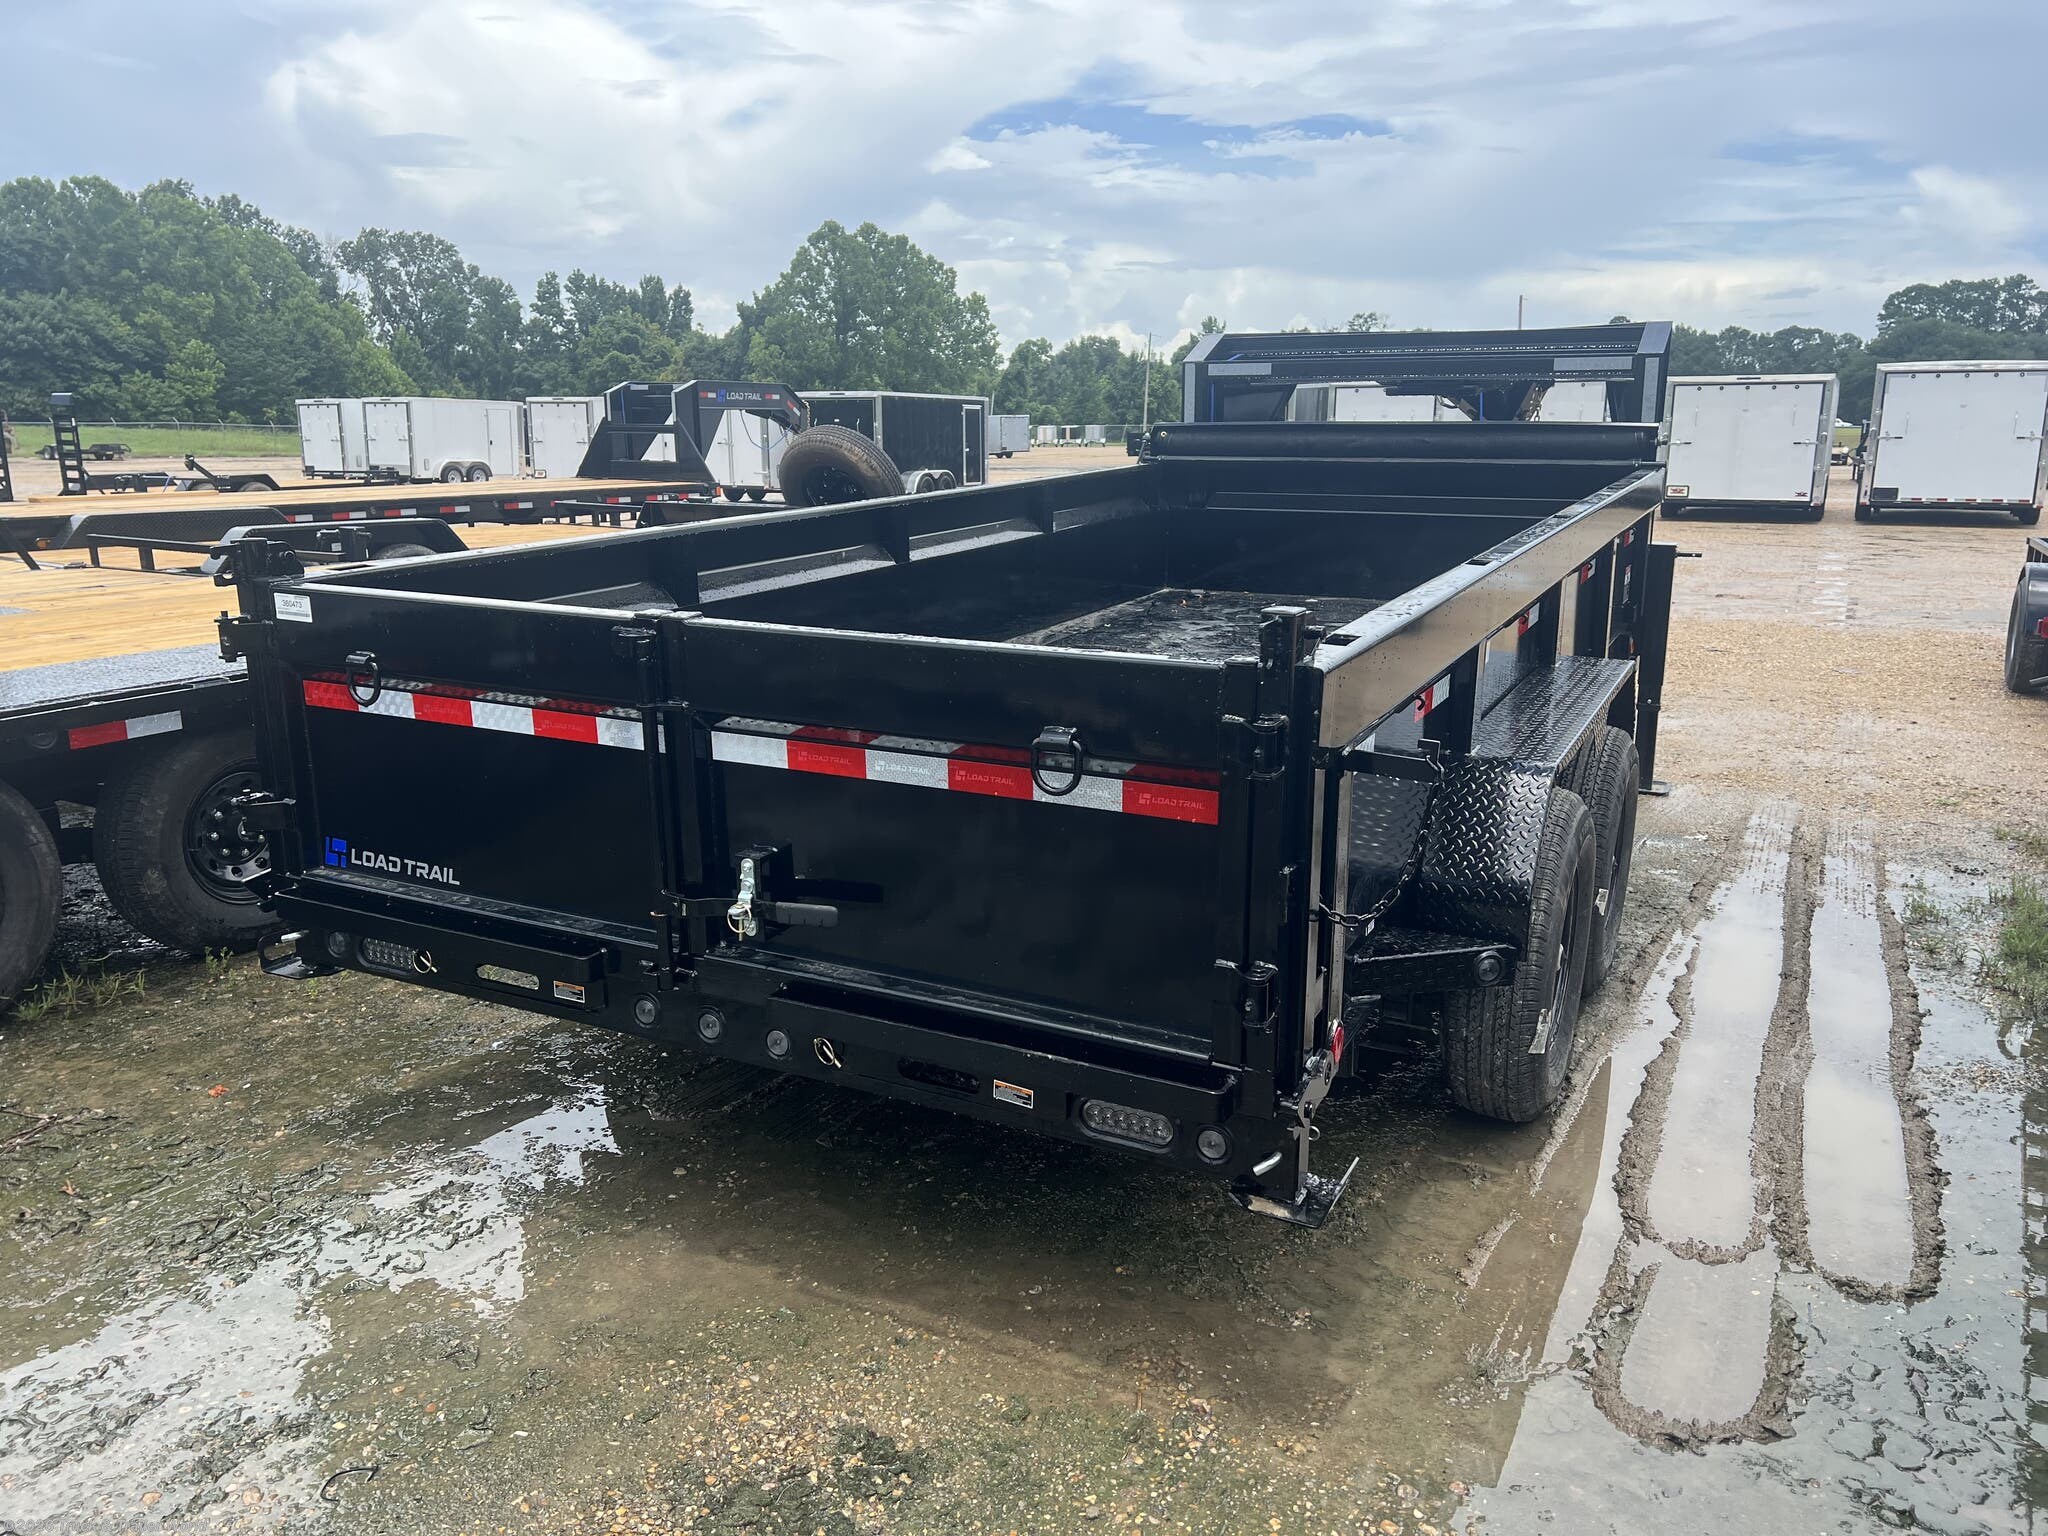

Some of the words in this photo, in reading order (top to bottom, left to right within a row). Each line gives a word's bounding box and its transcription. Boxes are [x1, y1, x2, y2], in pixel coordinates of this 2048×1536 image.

[726, 391, 744, 400] LOAD
[744, 391, 762, 401] TRAIL
[966, 773, 989, 782] LOAD
[989, 776, 1014, 785] TRAIL
[1152, 797, 1178, 806] LOAD
[1178, 800, 1206, 809] TRAIL
[351, 848, 401, 873] LOAD
[403, 859, 460, 885] TRAIL
